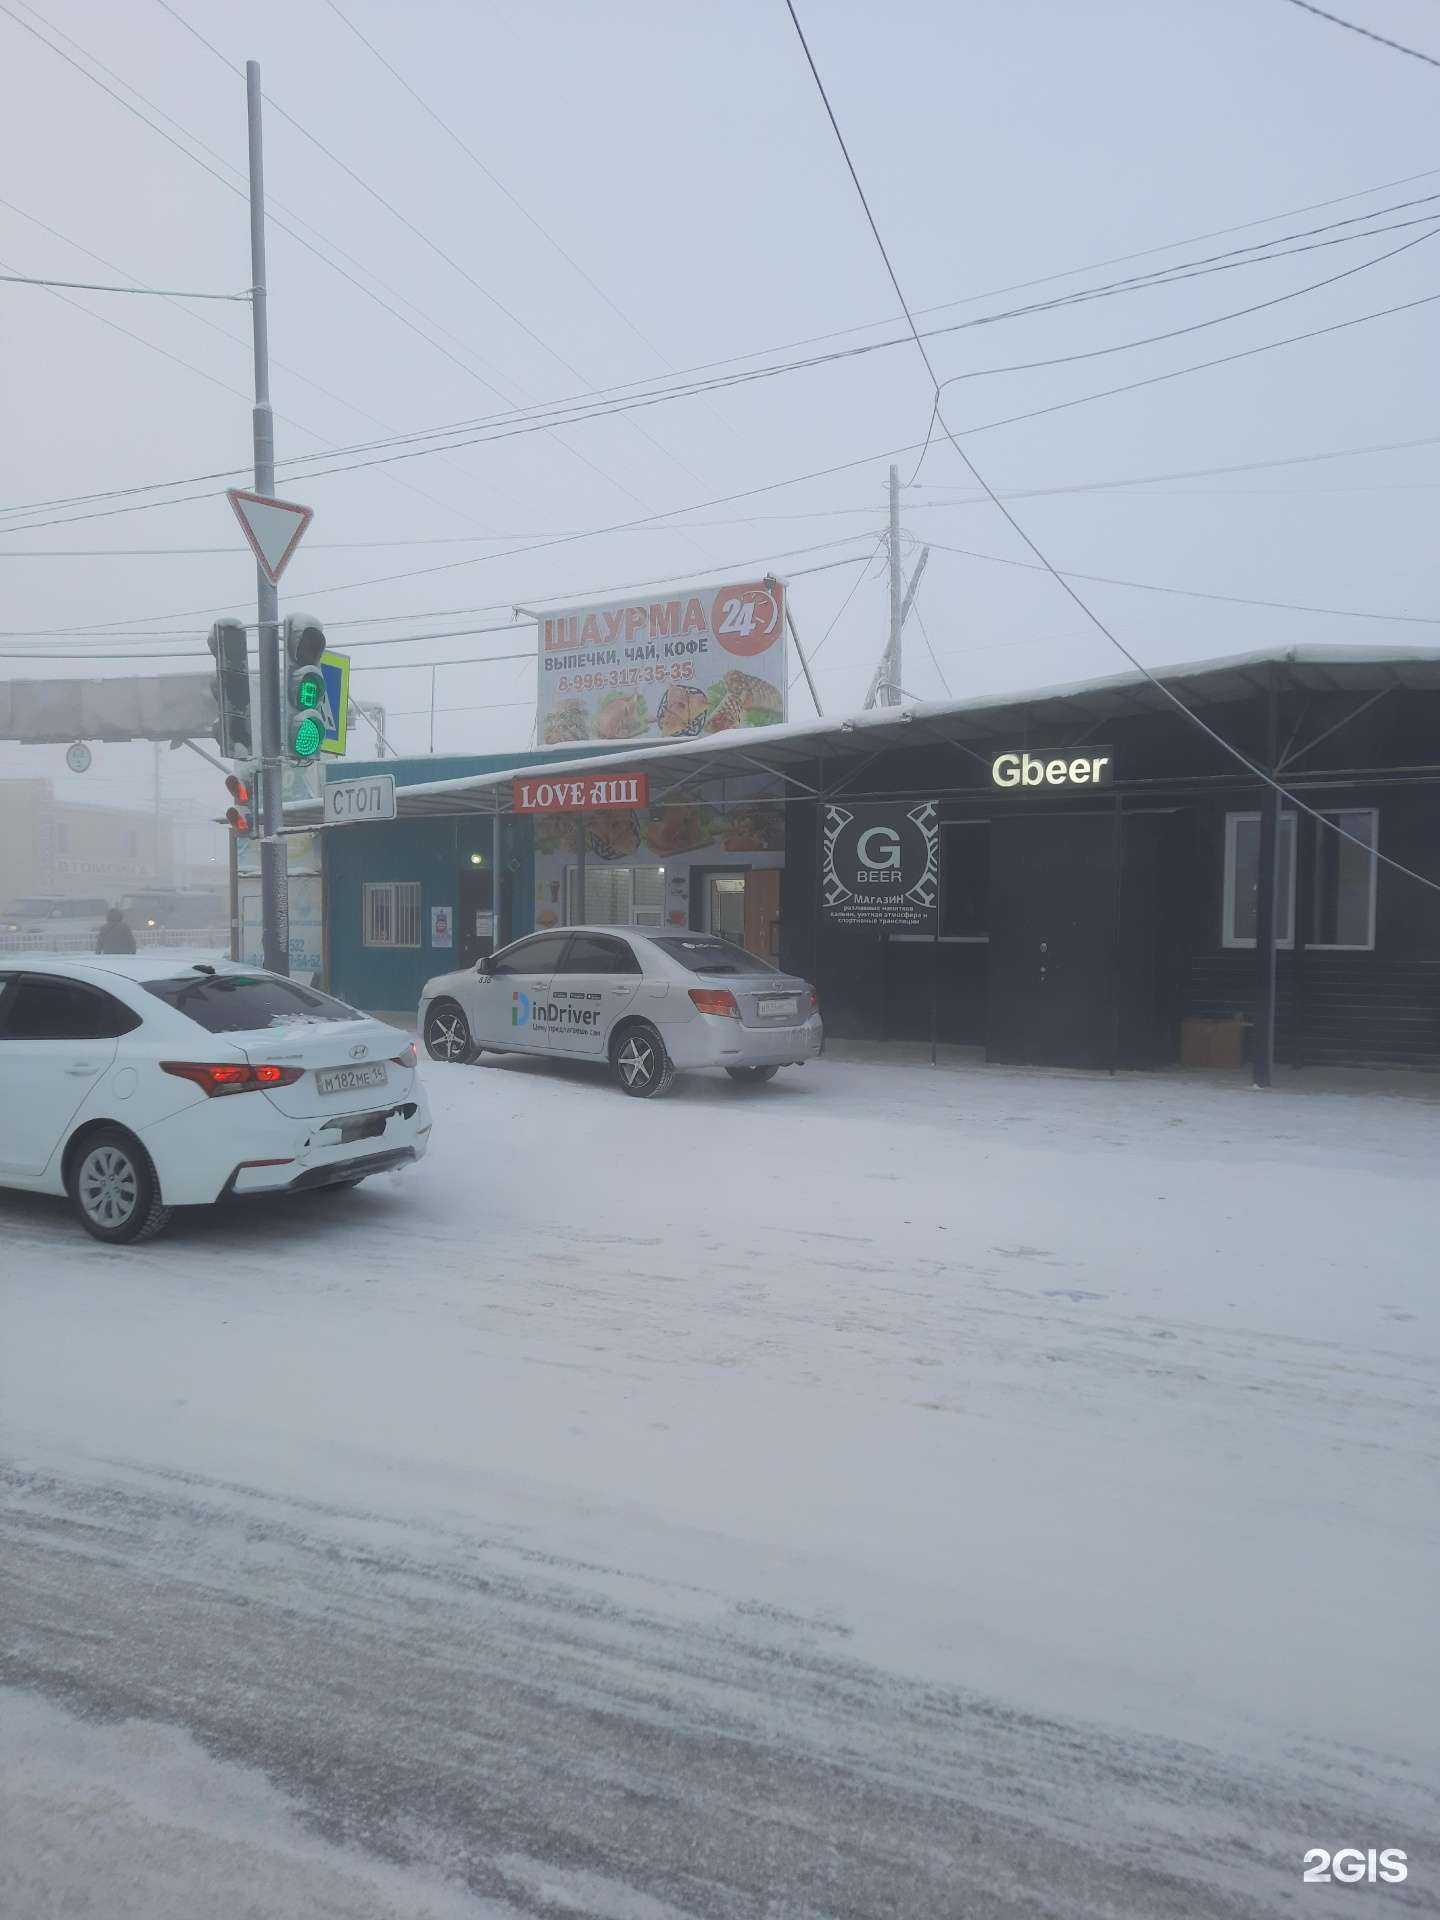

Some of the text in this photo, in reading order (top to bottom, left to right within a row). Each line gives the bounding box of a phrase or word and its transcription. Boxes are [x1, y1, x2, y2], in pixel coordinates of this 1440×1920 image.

[544, 598, 708, 651] ШАУРМА
[719, 599, 759, 637] 24
[544, 638, 709, 672] ВЫПЕЧКИ, ЧАЙ, КОФЕ
[992, 753, 1109, 787] Gbeer
[333, 786, 382, 815] СТОП
[521, 782, 587, 808] LOVE
[857, 826, 901, 869] G
[857, 870, 902, 883] BEER
[533, 1001, 601, 1026] inDriver
